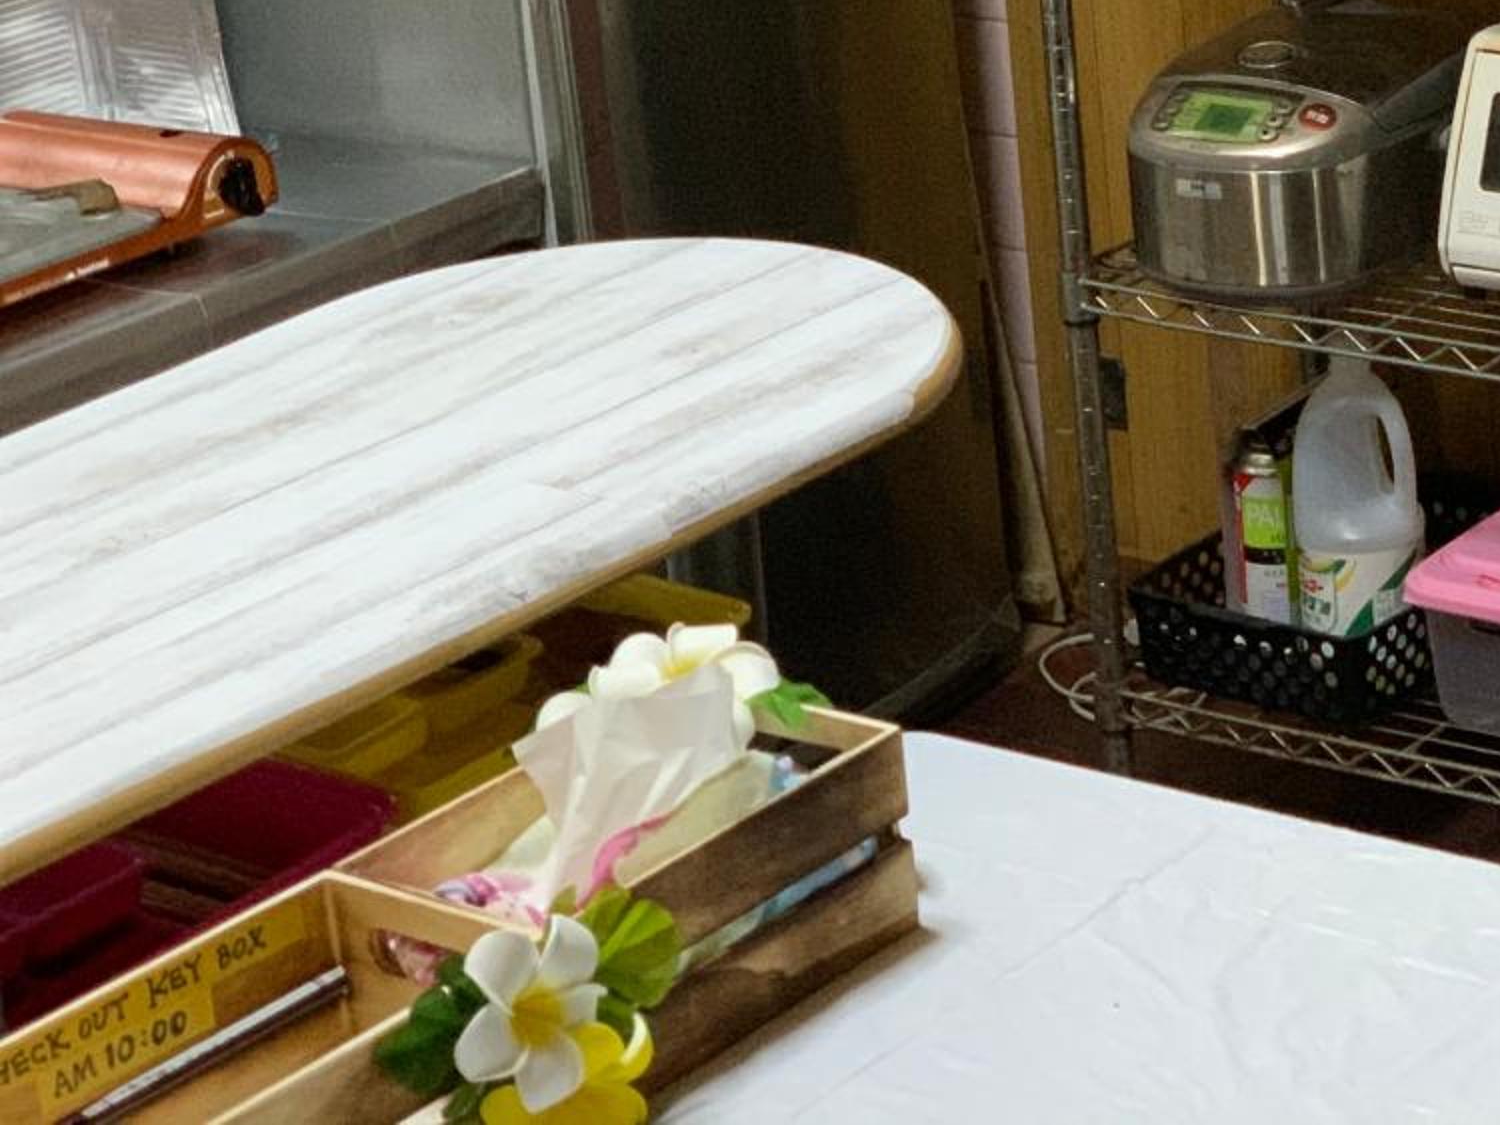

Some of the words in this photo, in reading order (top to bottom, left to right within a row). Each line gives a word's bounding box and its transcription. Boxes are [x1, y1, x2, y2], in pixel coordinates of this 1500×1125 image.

[78, 993, 129, 1040] OUT
[146, 954, 203, 1008] KEY
[216, 926, 267, 970] BOX
[53, 1061, 97, 1098] AM
[105, 1011, 188, 1070] 10:00
